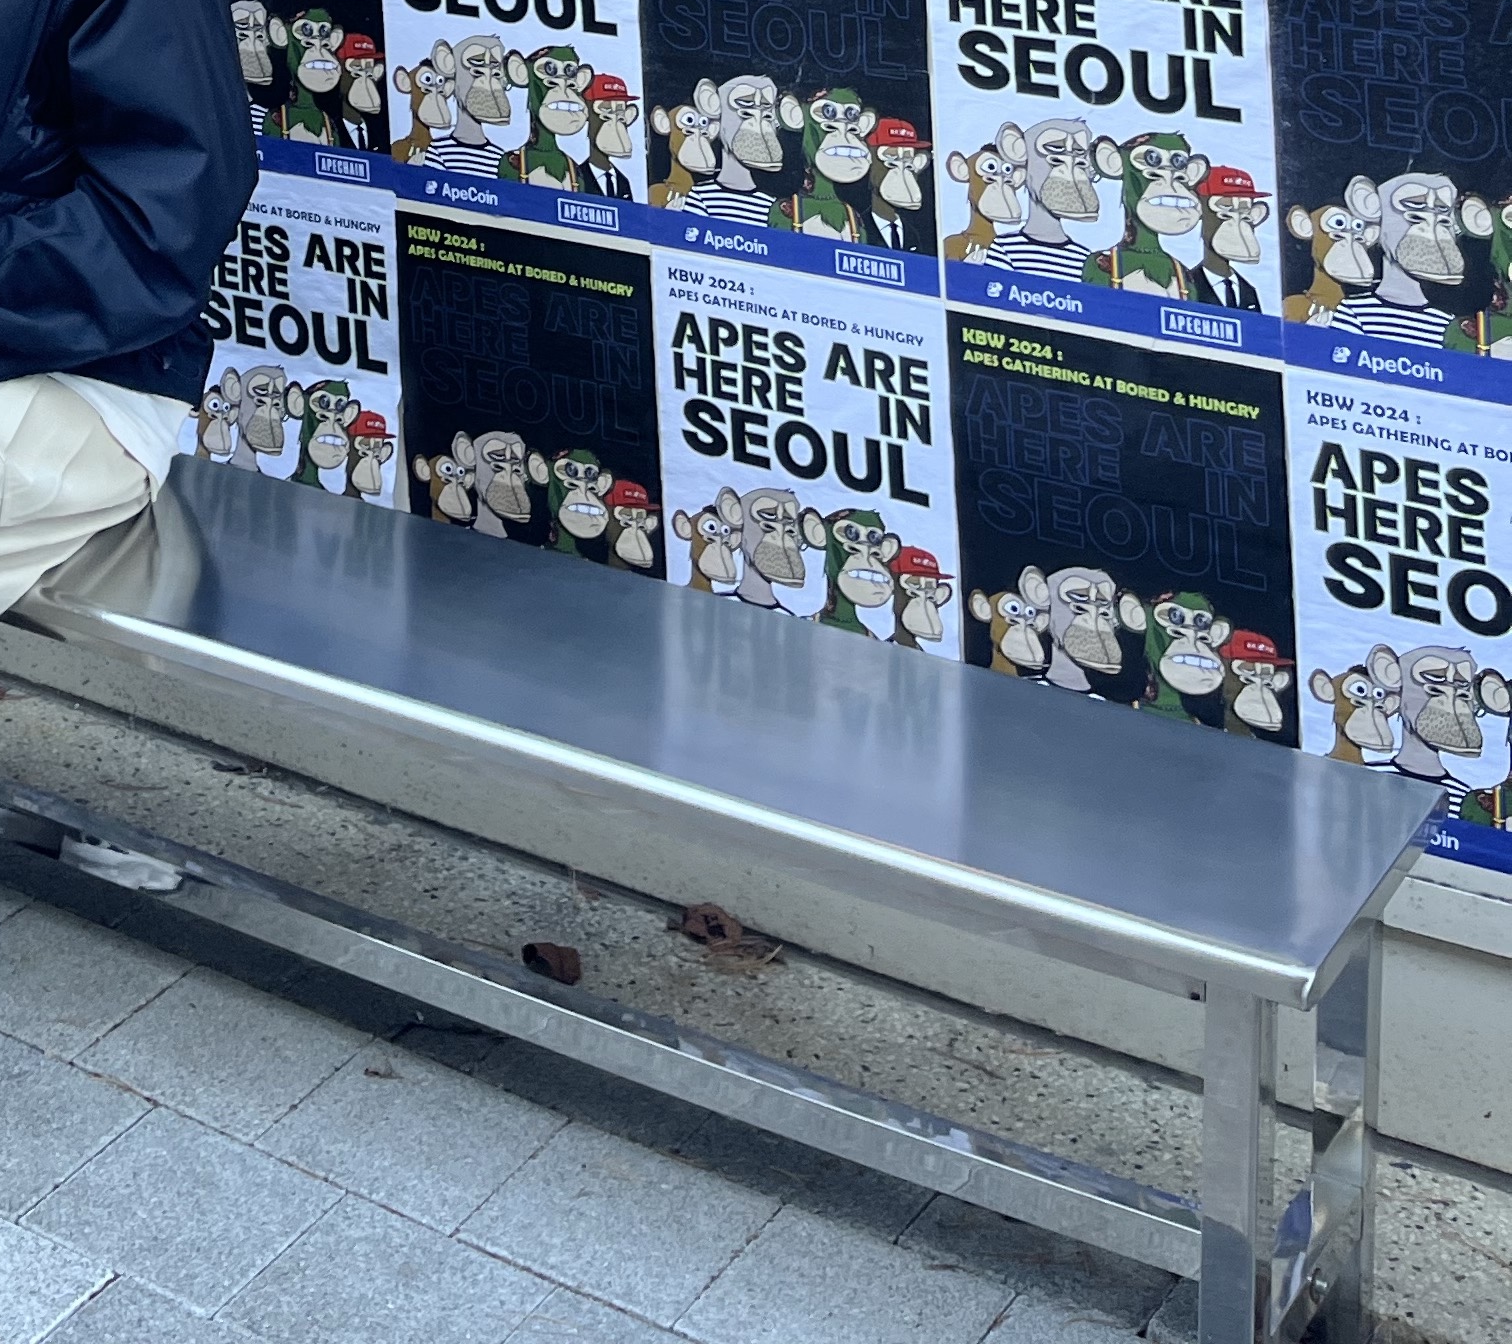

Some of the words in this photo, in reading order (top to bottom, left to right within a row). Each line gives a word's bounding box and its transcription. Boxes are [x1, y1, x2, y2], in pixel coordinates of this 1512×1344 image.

[1184, 7, 1243, 57] IN
[957, 30, 1242, 124] SEOUL
[442, 182, 498, 207] ApeCoin
[563, 202, 616, 228] APECHAIN
[285, 209, 321, 224] BORED
[334, 217, 380, 234] HUNGRY
[408, 225, 441, 243] KBW
[444, 233, 478, 251] 2024
[704, 229, 768, 255] ApeCoin
[303, 232, 386, 281] ARE
[841, 255, 899, 281] APECHAIN
[347, 277, 389, 321] IN
[668, 266, 704, 285] KBW
[708, 274, 746, 295] 2024
[1008, 288, 1082, 313] ApeCoin
[207, 289, 388, 375] SEOUL
[668, 287, 700, 303] APES
[702, 293, 778, 319] GATHERING
[801, 312, 847, 333] BORED
[864, 324, 923, 347] HUNGRY
[1169, 315, 1235, 341] APECHAIN
[671, 311, 807, 374] APES
[823, 341, 931, 399] ARE
[962, 327, 1005, 349] KBW
[1009, 335, 1053, 360] 2024
[1357, 350, 1443, 382] ApeCoin
[673, 349, 804, 417] HERE
[879, 395, 932, 445] IN
[1002, 358, 1090, 386] GATHERING
[1116, 379, 1170, 403] BORED
[1189, 393, 1260, 420] HUNGRY
[1306, 390, 1354, 411] KBW
[1361, 401, 1409, 422] 2024
[681, 398, 931, 507] SEOUL
[1308, 413, 1347, 431] APES
[1353, 422, 1452, 452] GATHERING
[1310, 441, 1490, 516] APES
[1313, 484, 1486, 565] HERE
[1324, 542, 1512, 637] SEO
